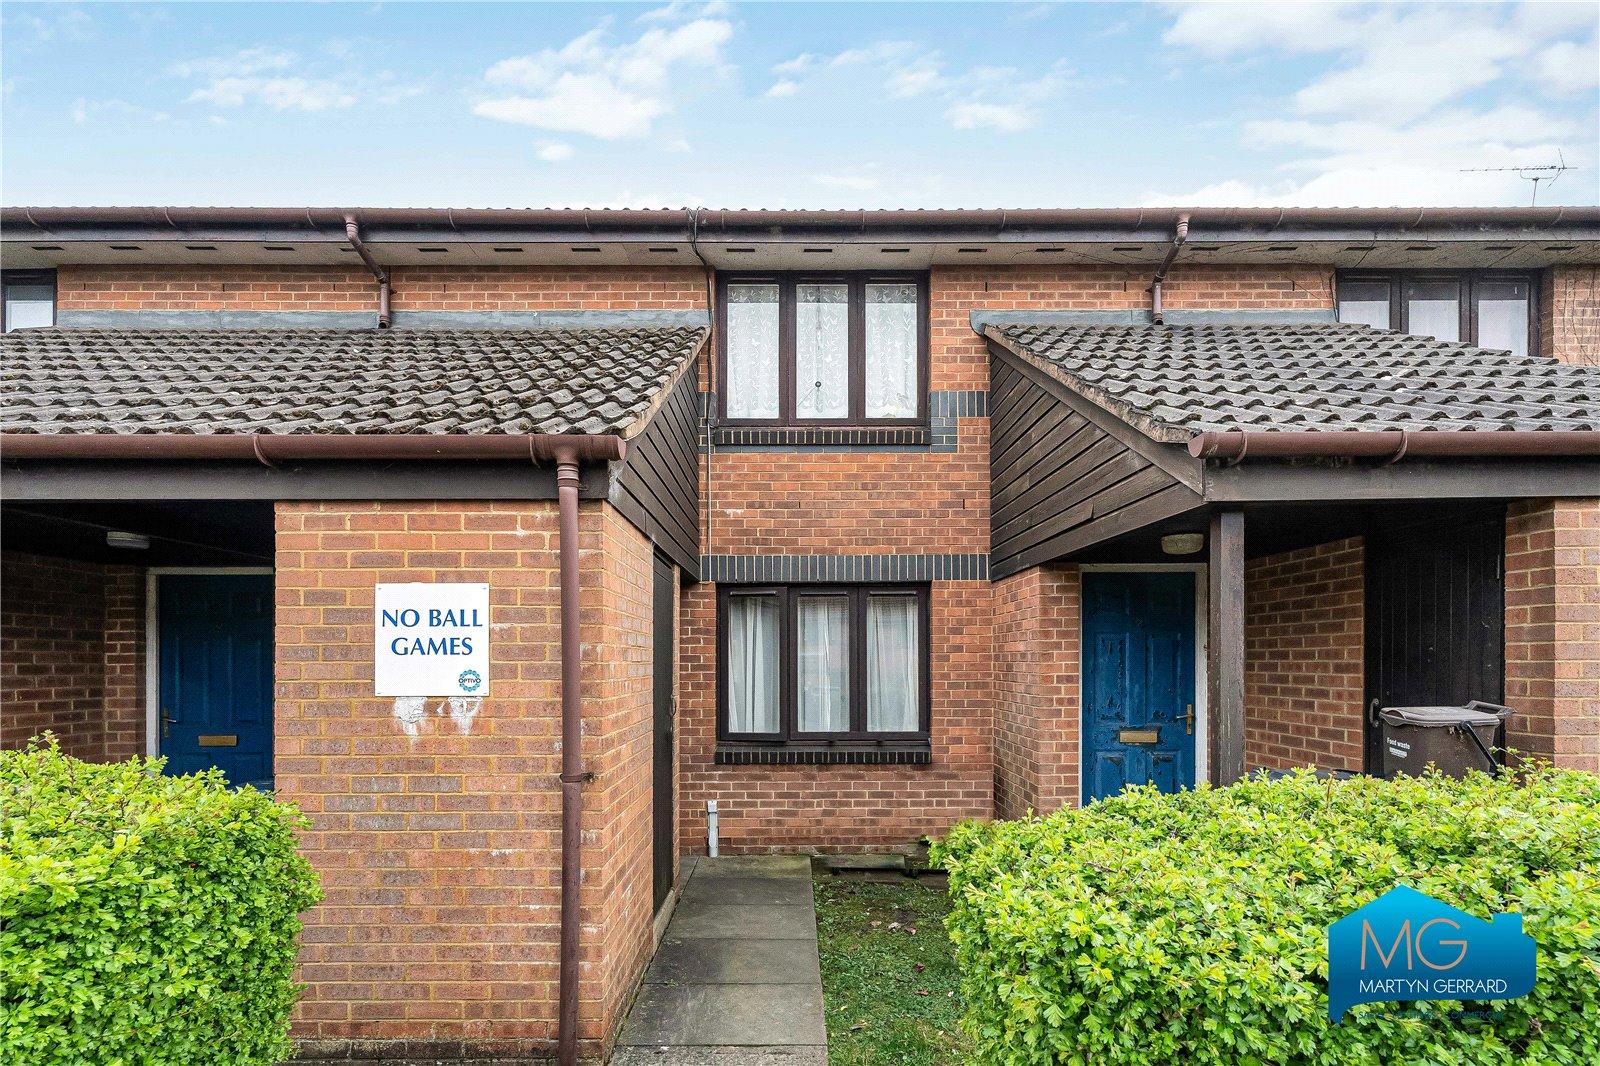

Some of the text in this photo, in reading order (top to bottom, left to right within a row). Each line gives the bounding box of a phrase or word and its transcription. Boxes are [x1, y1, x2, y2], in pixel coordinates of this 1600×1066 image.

[382, 608, 483, 628] NO BALL
[390, 636, 474, 656] GAMES
